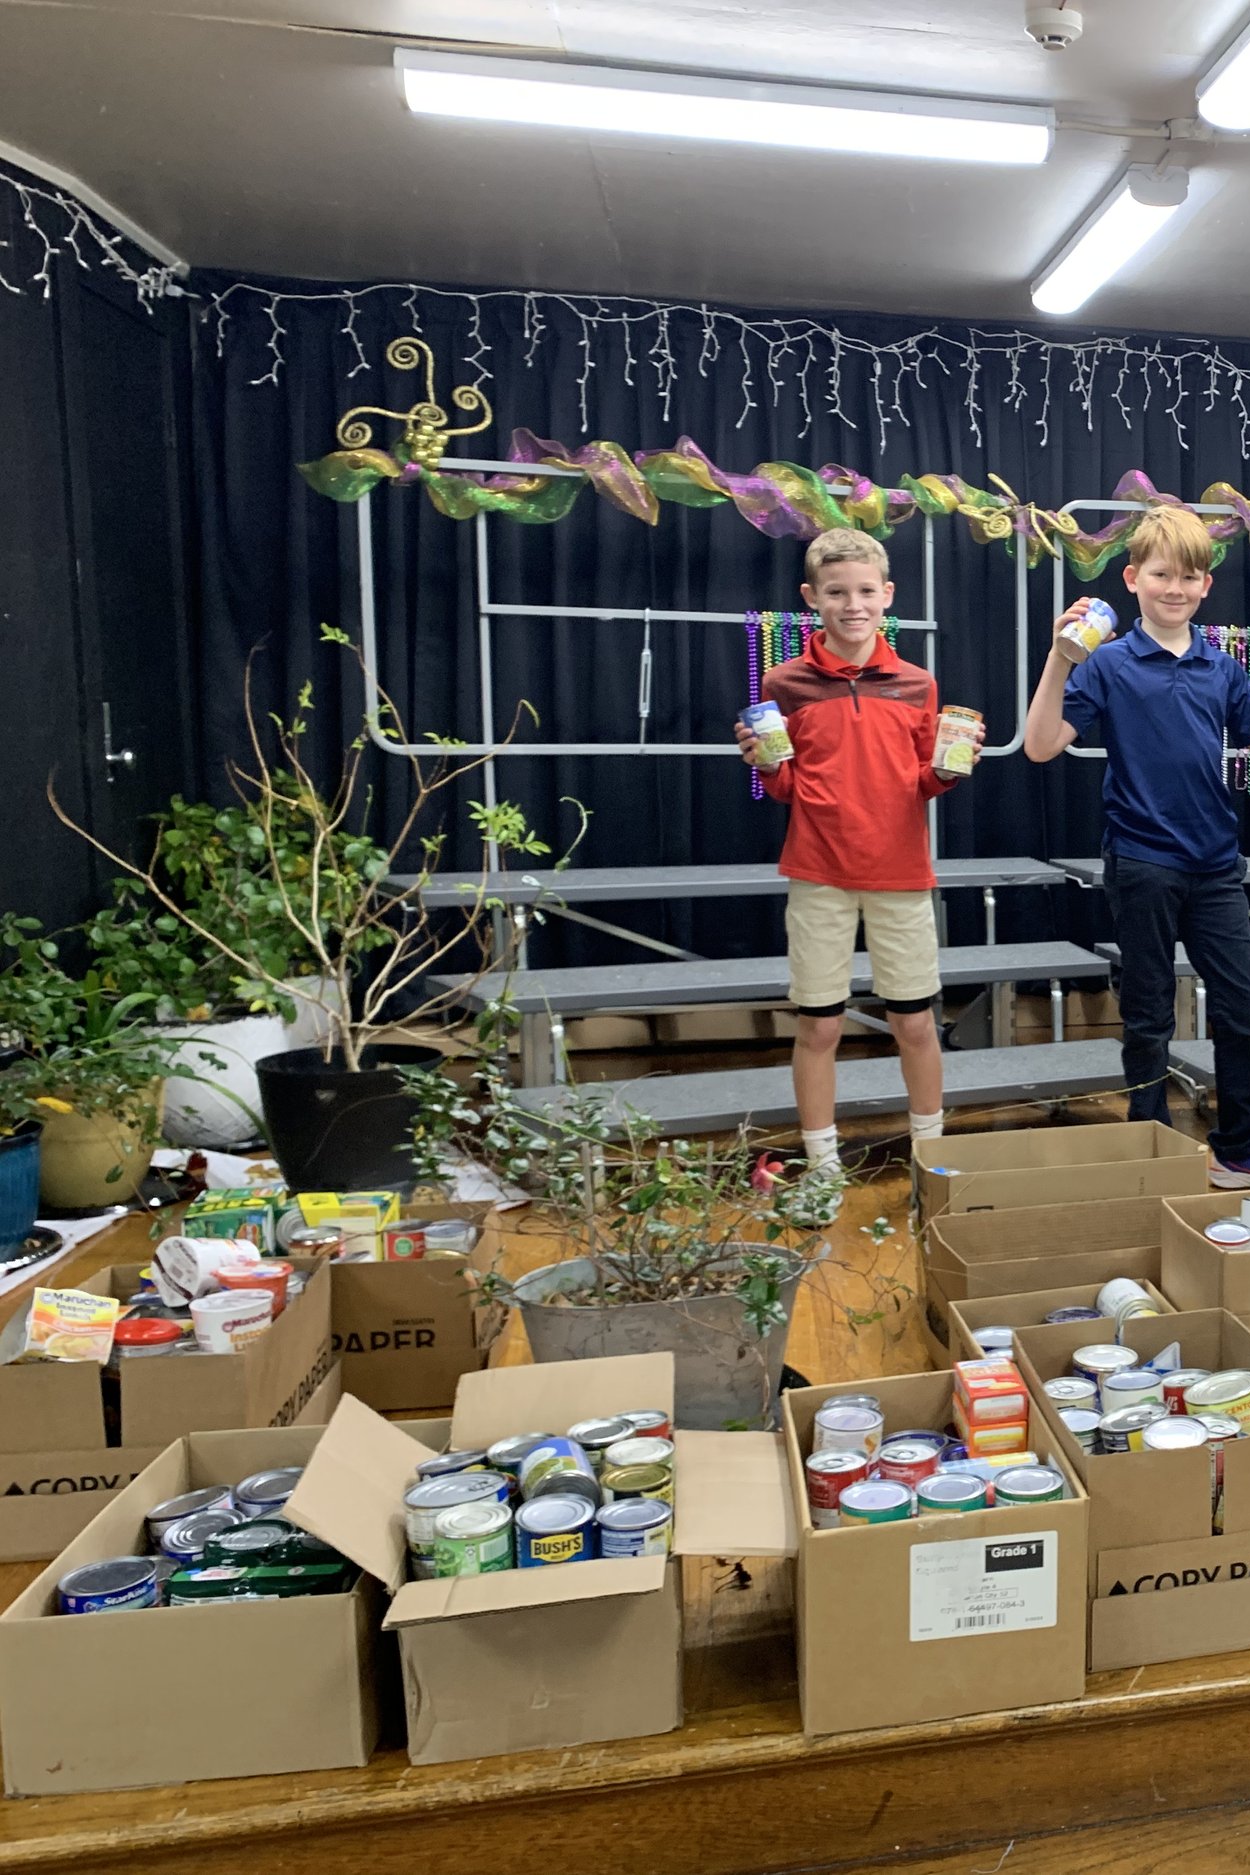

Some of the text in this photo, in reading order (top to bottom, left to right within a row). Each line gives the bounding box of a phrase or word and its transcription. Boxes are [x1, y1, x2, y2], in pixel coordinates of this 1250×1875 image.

[534, 1536, 582, 1556] BUSH'S
[991, 1544, 1037, 1558] Grade 1
